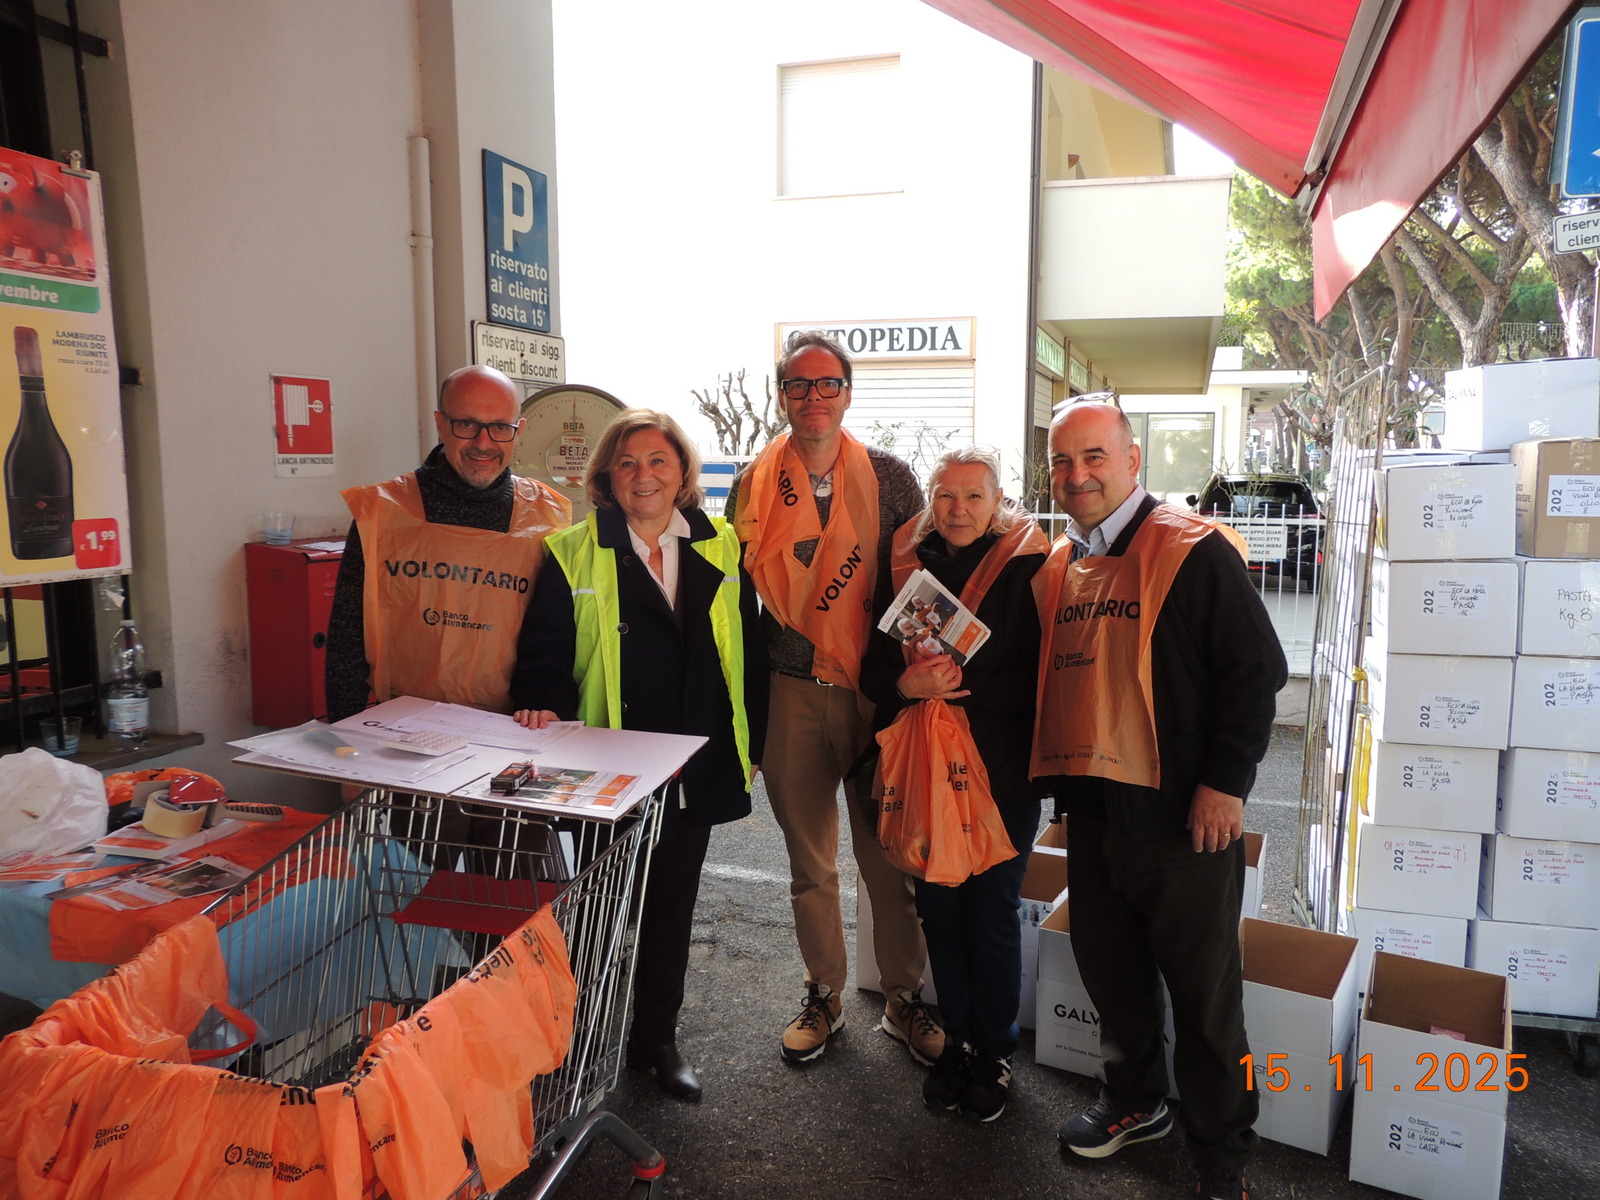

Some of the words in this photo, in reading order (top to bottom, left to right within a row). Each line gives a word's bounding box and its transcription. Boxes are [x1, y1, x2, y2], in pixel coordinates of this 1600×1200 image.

[501, 162, 534, 252] P
[1567, 234, 1600, 247] clien
[490, 250, 548, 281] riservato
[490, 276, 503, 294] ai
[508, 281, 548, 305] clienti
[491, 303, 527, 324] sosta
[52, 339, 89, 348] MODENA
[90, 342, 107, 350] DOC
[56, 330, 106, 342] LAMBRUSCO
[481, 330, 526, 352] riservato
[529, 340, 538, 355] ai
[788, 325, 962, 353] TOPEDIA
[76, 349, 109, 358] RIUNITE
[486, 355, 516, 375] clienti
[520, 359, 558, 380] discount
[563, 422, 584, 430] BETA
[278, 457, 297, 465] LANCIA
[299, 457, 334, 465] ANTINCENDIO
[560, 446, 589, 457] BETA
[1551, 489, 1563, 512] 202
[1423, 505, 1434, 528] 202
[385, 560, 529, 595] VOLONTARIO
[1423, 590, 1434, 613] 202
[1557, 588, 1591, 602] PASTA
[443, 611, 469, 621] Banco
[1057, 600, 1140, 625] LONTARIO
[1559, 608, 1579, 629] Kg
[1580, 608, 1592, 621] 8
[1065, 652, 1083, 660] Banco
[1543, 683, 1556, 707] 202
[1420, 705, 1431, 728] 202
[1403, 766, 1413, 788] 202
[95, 1123, 130, 1140] Banco
[1389, 1124, 1402, 1150] 202
[276, 1163, 326, 1184] Alimentar
[279, 1161, 302, 1175] Banco
